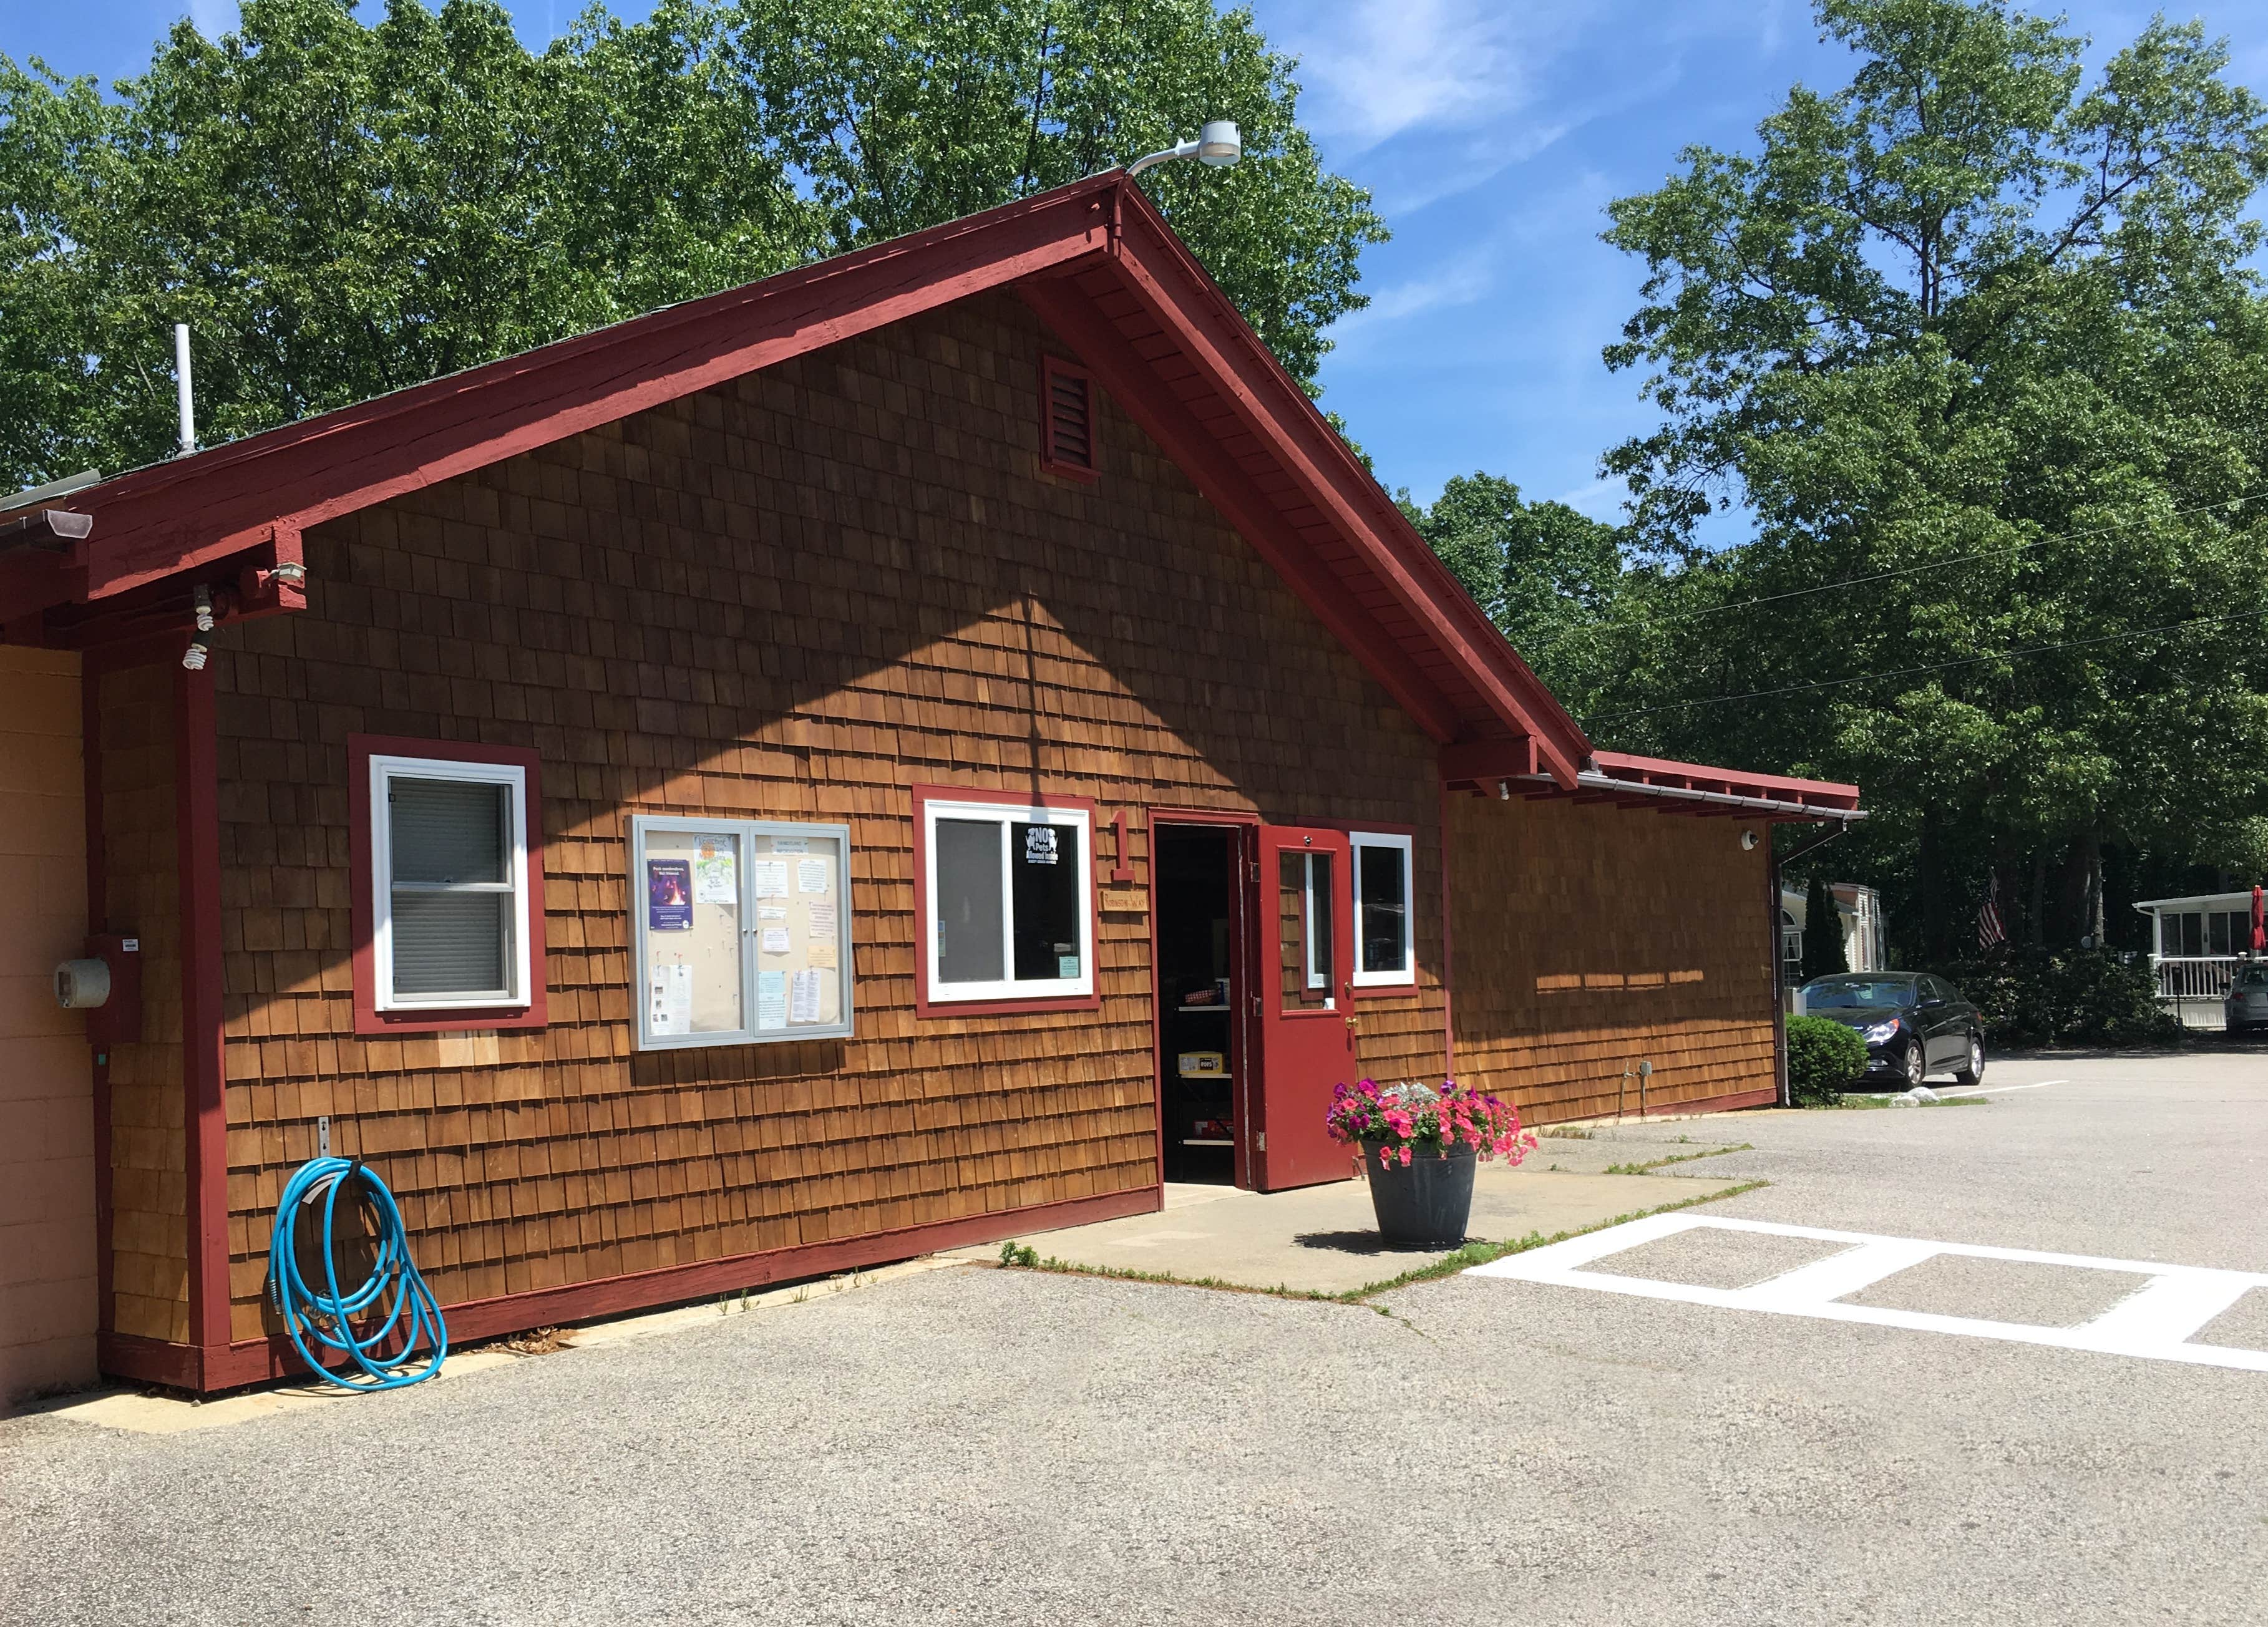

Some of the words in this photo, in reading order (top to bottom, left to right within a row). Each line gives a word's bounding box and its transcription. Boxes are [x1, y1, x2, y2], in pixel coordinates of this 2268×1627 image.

[1035, 827, 1049, 843] NO
[1036, 842, 1049, 851] Pets
[1110, 810, 1136, 880] 1
